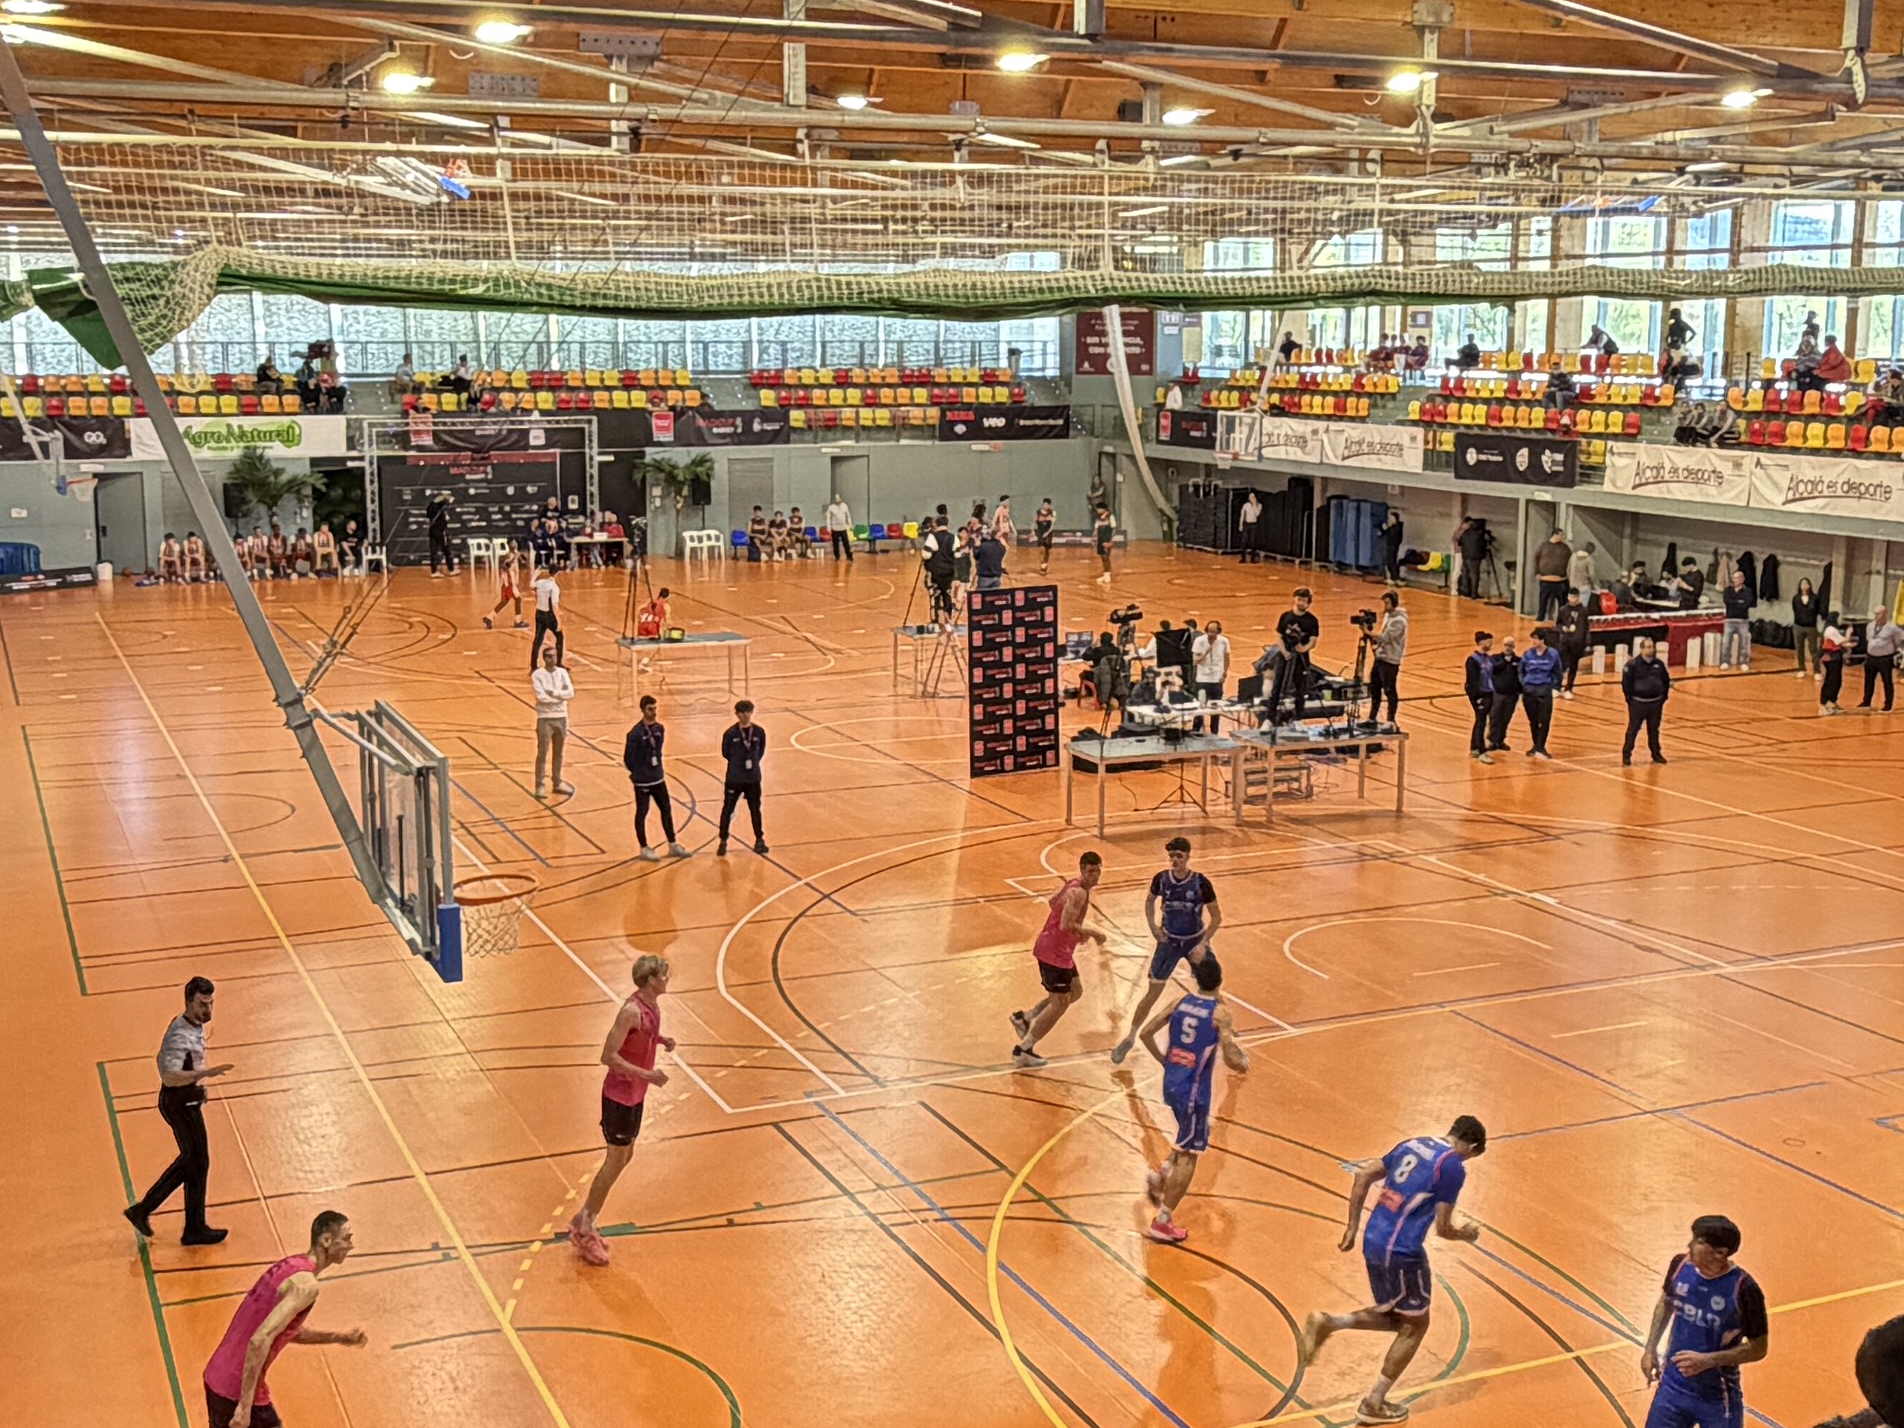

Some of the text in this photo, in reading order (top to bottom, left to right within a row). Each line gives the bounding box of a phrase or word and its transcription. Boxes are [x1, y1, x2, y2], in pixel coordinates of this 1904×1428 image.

[1784, 473, 1893, 502] Alcalá es deporte
[1180, 1016, 1200, 1044] 5
[1394, 1154, 1418, 1184] 8
